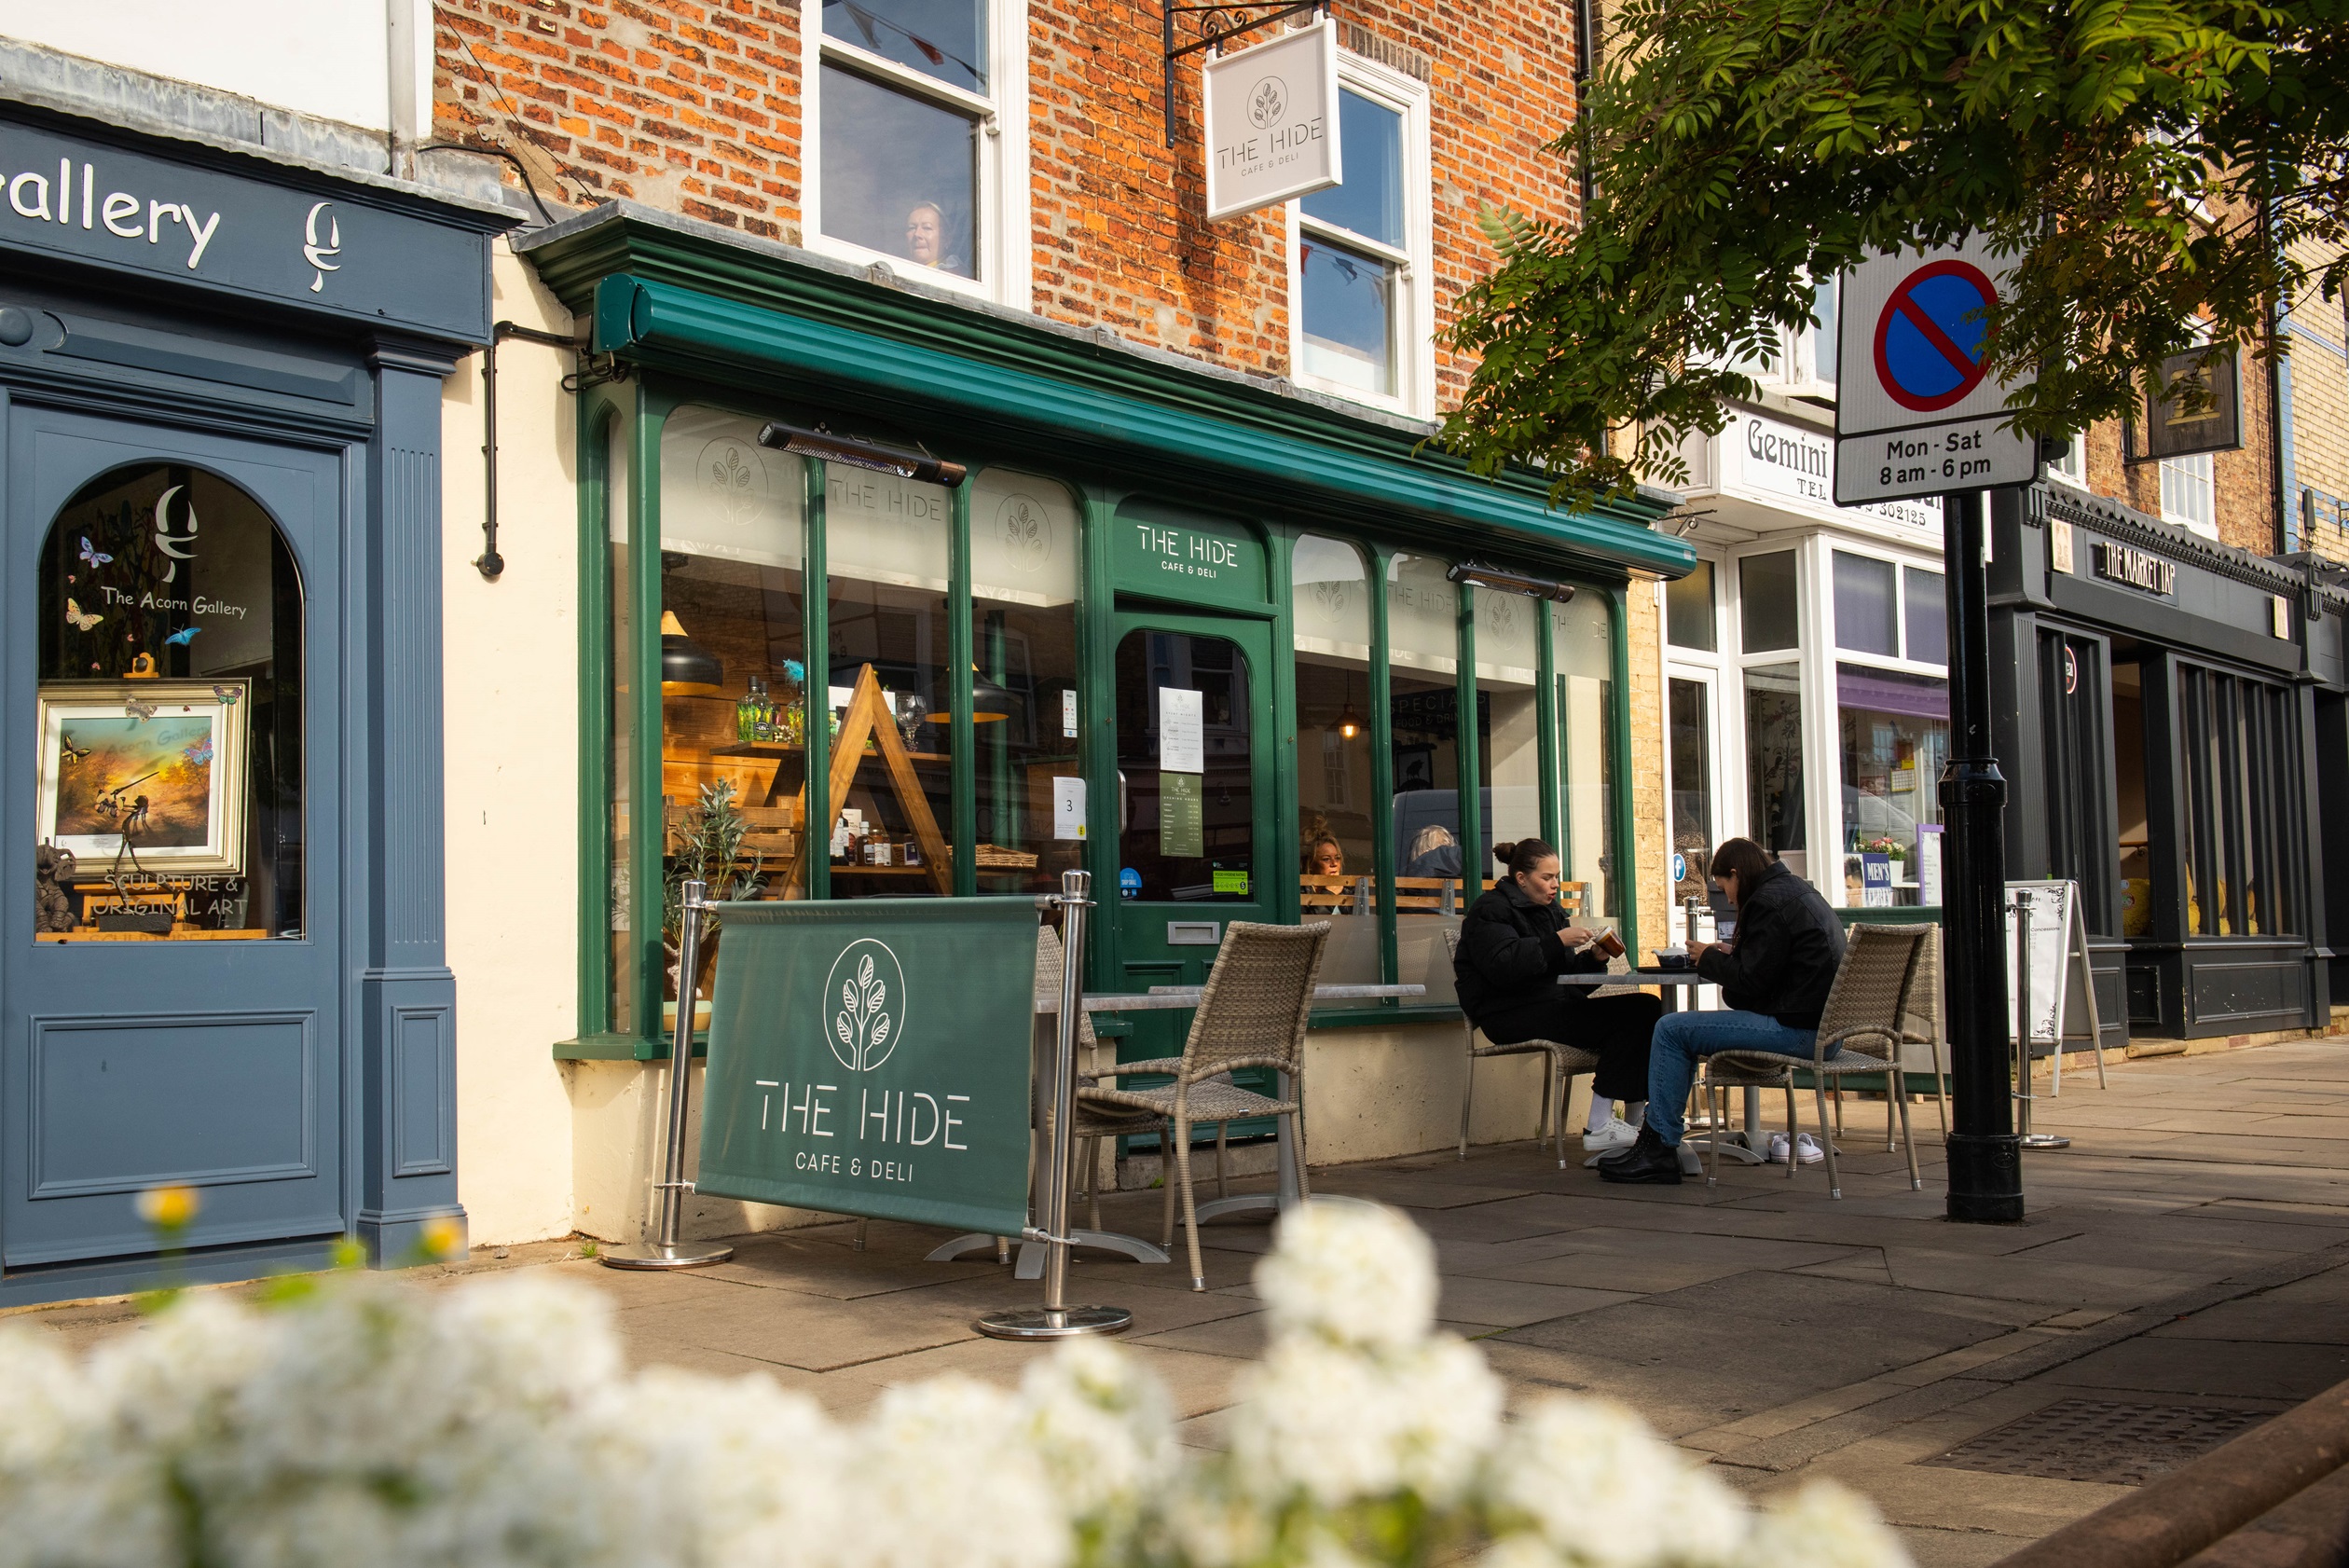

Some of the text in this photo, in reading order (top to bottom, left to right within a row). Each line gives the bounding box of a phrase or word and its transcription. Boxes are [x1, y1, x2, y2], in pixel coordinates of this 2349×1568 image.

[1216, 117, 1323, 169] THE HIDE
[1241, 163, 1264, 177] CAFE
[1278, 152, 1298, 165] DELI
[0, 158, 220, 269] allery
[1748, 419, 1827, 478] Gemini
[1887, 440, 1928, 460] Mon
[1945, 430, 1982, 452] Sat
[829, 478, 941, 521] THE HIDE
[1797, 477, 1827, 501] TEL
[1879, 502, 1926, 526] 302125
[1137, 525, 1238, 567] THE HIDE
[1161, 560, 1216, 579] CAFE & DELI
[2104, 542, 2176, 596] THE MARKET TAP
[101, 585, 247, 620] The Acorn Gallery
[1387, 584, 1453, 613] THE HIDE
[1066, 799, 1073, 812] 3
[103, 873, 239, 892] SCULPTURE &
[1866, 862, 1889, 881] MEN'S
[93, 897, 248, 915] ORIGINAL ART
[756, 1080, 970, 1150] THE HIDE
[795, 1151, 913, 1182] CAFE & DELI
